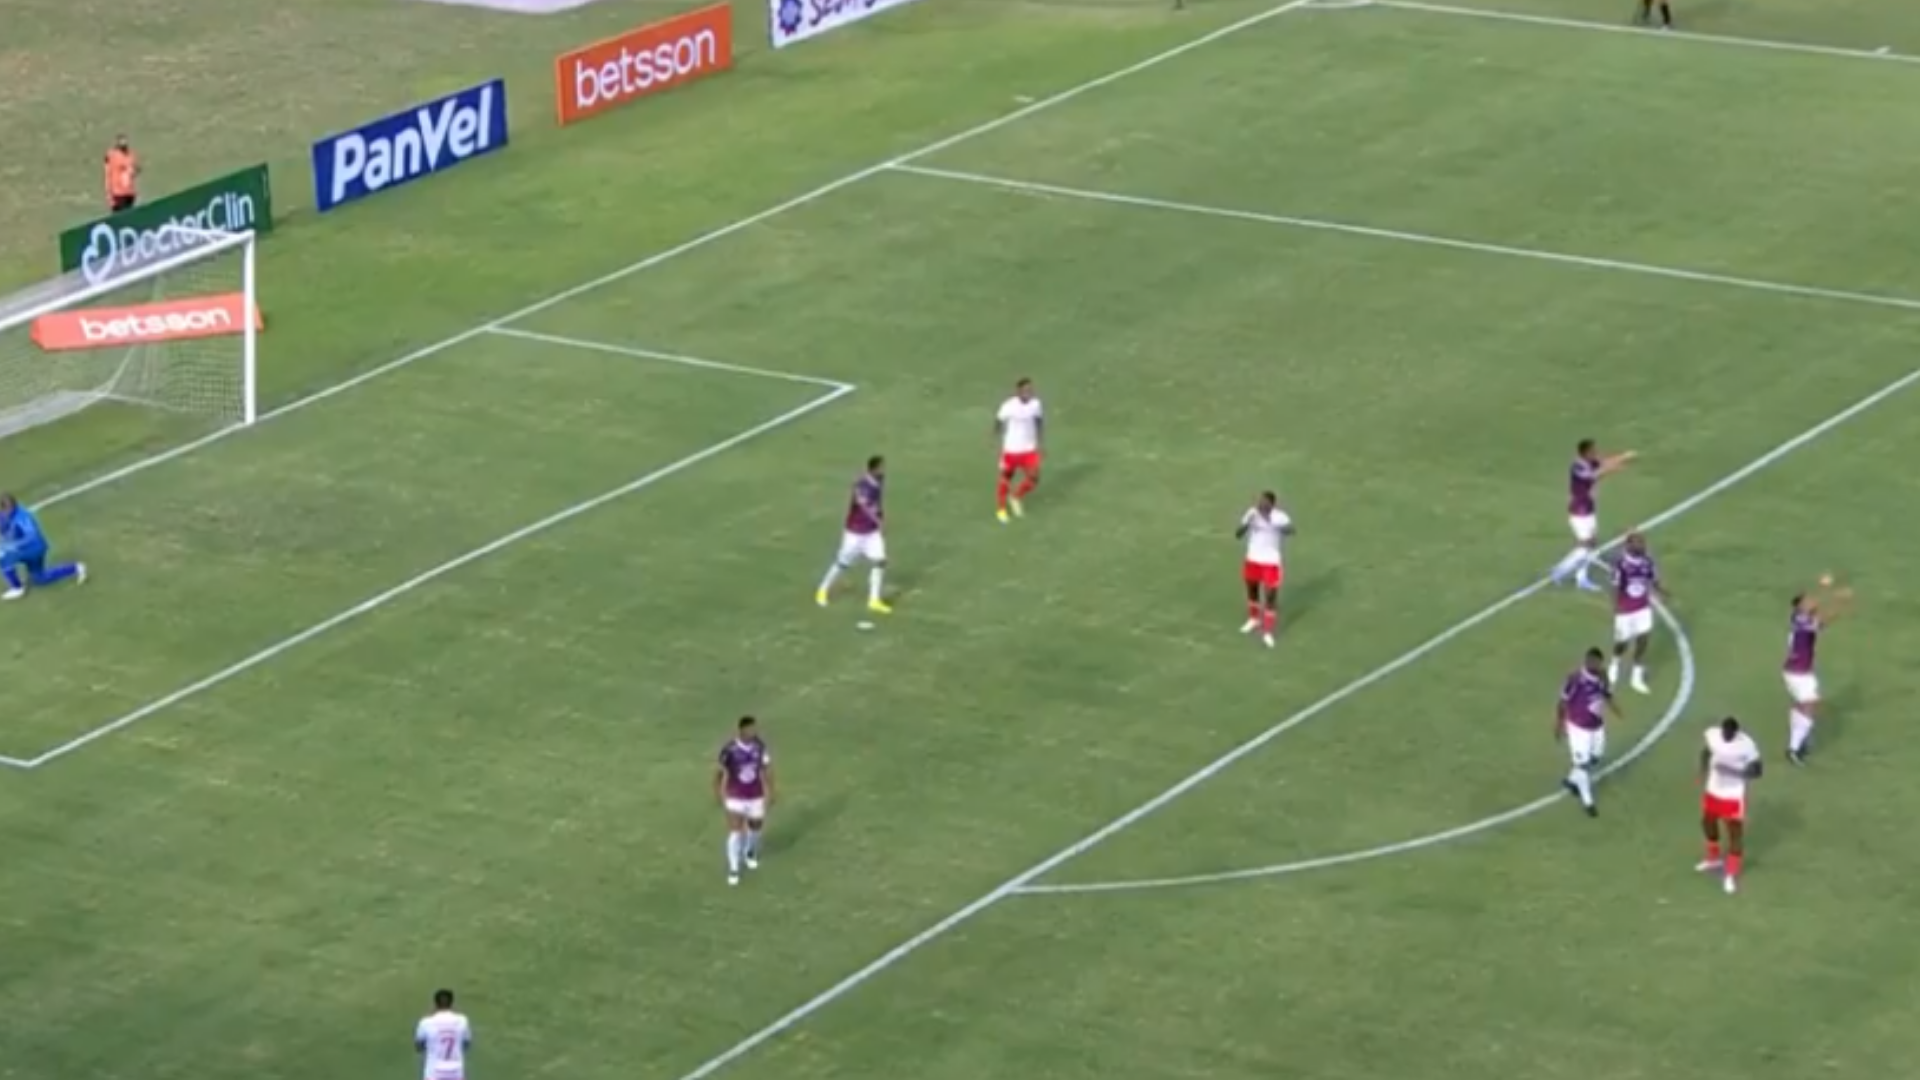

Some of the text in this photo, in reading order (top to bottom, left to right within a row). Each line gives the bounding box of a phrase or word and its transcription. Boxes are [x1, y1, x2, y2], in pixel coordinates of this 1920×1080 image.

[575, 28, 716, 109] betsson
[331, 85, 493, 203] PanVel
[79, 306, 231, 341] betsson
[439, 1036, 456, 1061] 7
